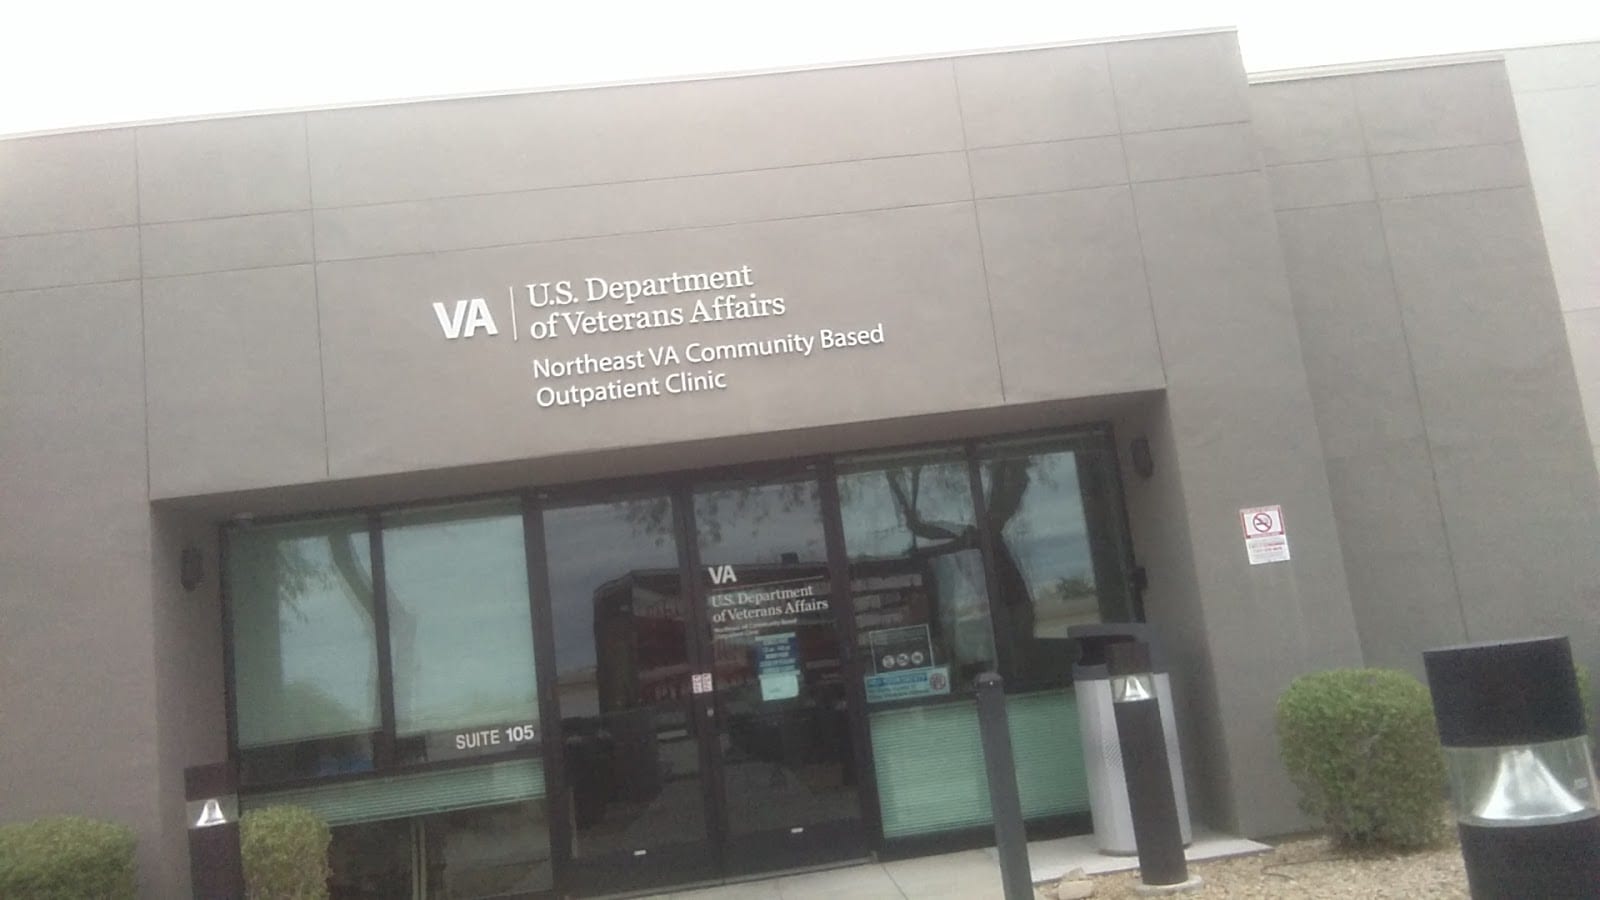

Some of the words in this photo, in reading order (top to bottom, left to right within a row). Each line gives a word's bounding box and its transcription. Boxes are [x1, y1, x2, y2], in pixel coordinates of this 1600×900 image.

[526, 280, 579, 308] U.S.
[585, 265, 754, 304] Department
[432, 298, 499, 339] VA
[530, 312, 561, 340] of
[562, 306, 684, 335] Veterans
[689, 293, 786, 324] Affairs
[533, 349, 645, 378] Northeast
[648, 346, 680, 367] VA
[685, 333, 815, 363] Community
[820, 322, 885, 348] Based
[536, 377, 660, 407] Outpatient
[665, 370, 728, 394] Clinic
[708, 565, 738, 585] VA
[711, 594, 734, 608] U.S.
[737, 585, 814, 606] Department
[712, 609, 727, 624] of
[727, 604, 783, 621] Veterans
[784, 598, 829, 615] Affairs
[455, 729, 501, 750] SUITE
[505, 724, 535, 743] 105
